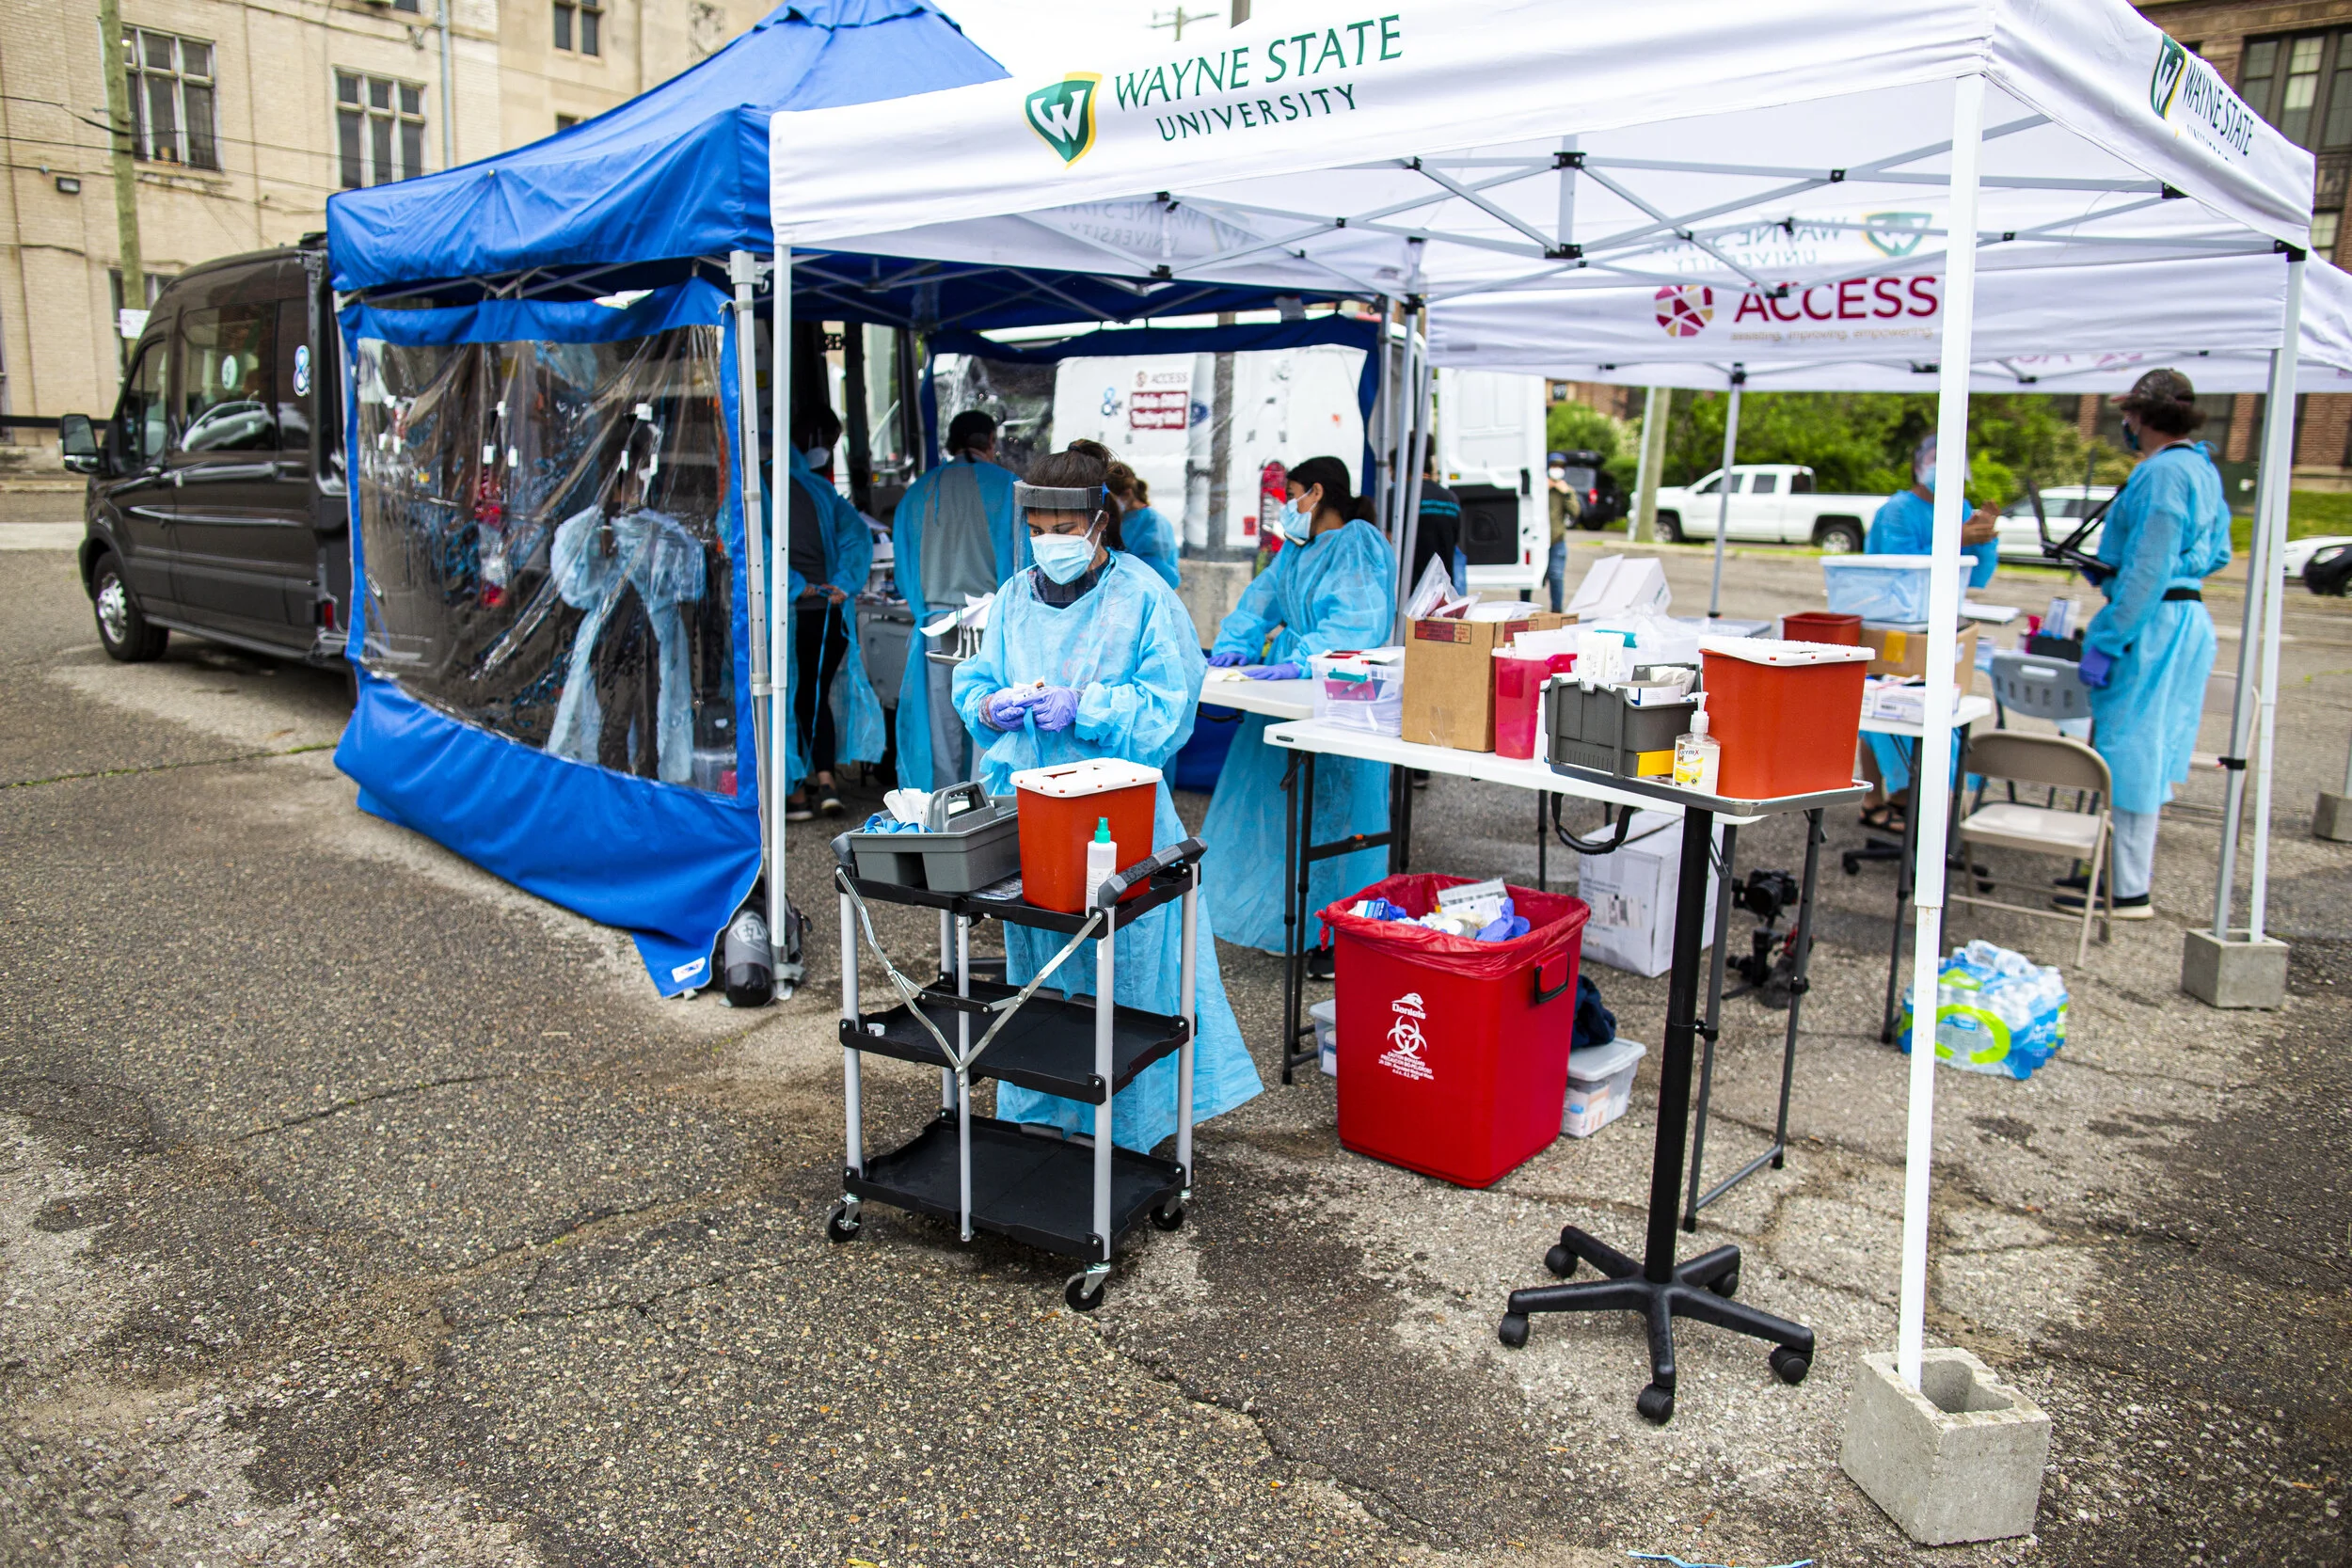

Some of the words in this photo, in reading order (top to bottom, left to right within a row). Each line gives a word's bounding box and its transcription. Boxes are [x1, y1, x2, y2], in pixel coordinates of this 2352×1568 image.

[1115, 47, 1250, 112] WAYNE
[1265, 14, 1403, 83] STATE
[1156, 84, 1357, 141] UNIVERSITY
[2183, 59, 2223, 129] WAYNE
[2219, 97, 2254, 156] STATE
[1733, 276, 1939, 324] ACCESS
[1151, 372, 1187, 384] ACCESS
[1392, 1003, 1427, 1020] Daniels
